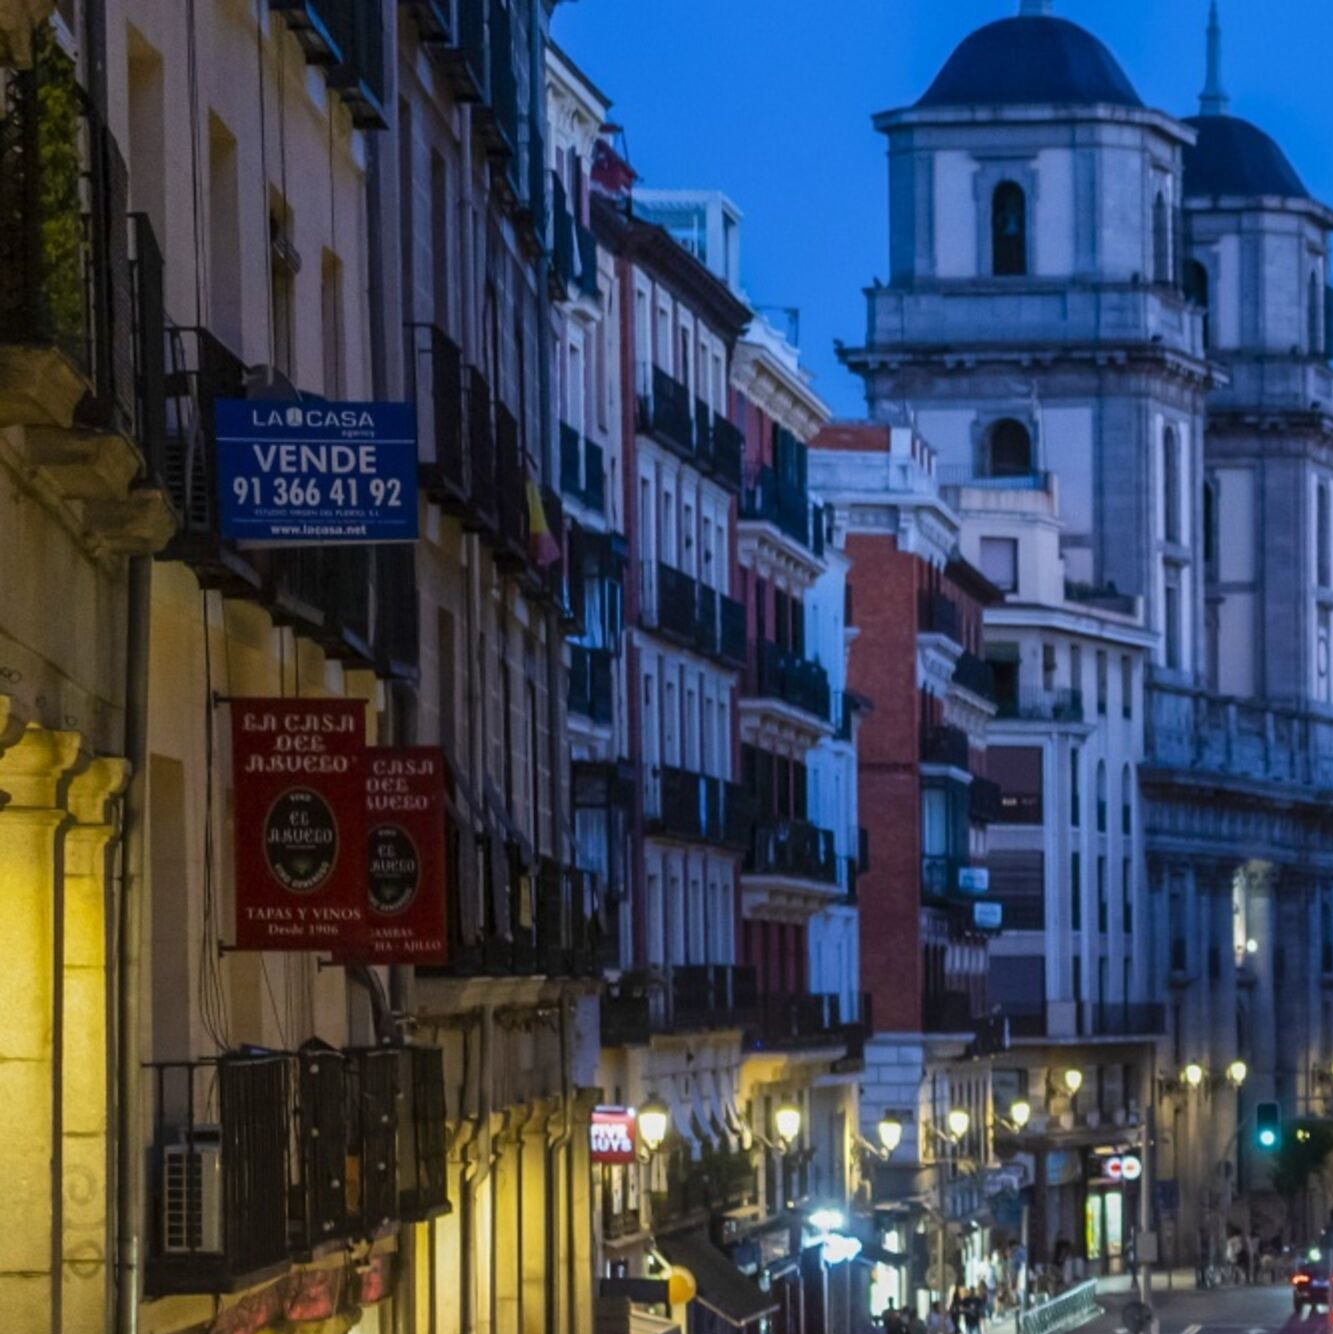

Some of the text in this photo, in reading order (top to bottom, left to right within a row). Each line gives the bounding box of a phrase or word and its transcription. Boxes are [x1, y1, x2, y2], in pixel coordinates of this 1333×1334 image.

[253, 408, 375, 428] LA CASA
[252, 444, 377, 474] VENDE
[233, 476, 402, 507] 91 366 41 92
[242, 714, 355, 732] LA CASA
[273, 735, 328, 752] DEL
[245, 755, 349, 773] ABUELO
[372, 759, 434, 774] CASA
[246, 906, 361, 921] TAPAS Y VINOS
